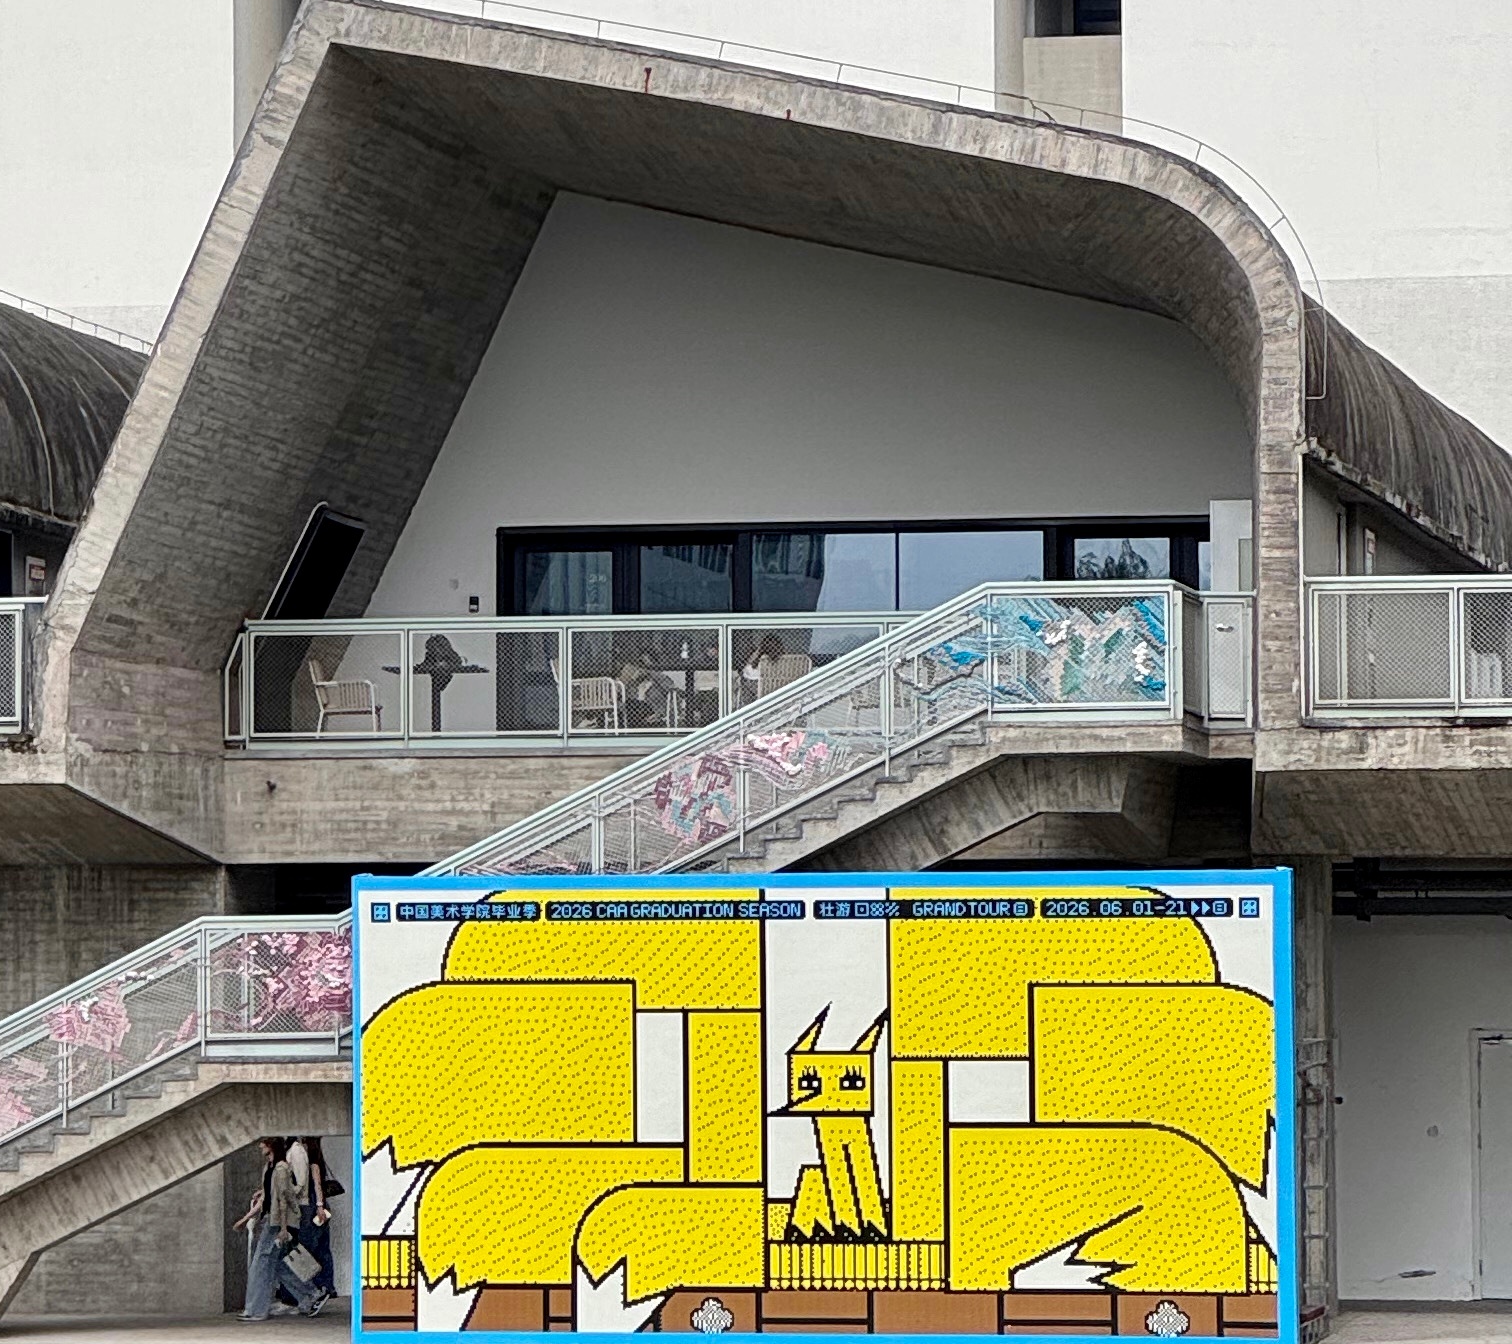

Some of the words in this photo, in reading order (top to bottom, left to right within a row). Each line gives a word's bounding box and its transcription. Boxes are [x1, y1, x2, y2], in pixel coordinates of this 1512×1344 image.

[399, 903, 537, 920] 中国美术学院毕业季
[551, 903, 592, 919] 2026
[596, 903, 628, 918] CAA
[630, 903, 734, 918] GRADUATION
[738, 902, 801, 918] SEASON
[819, 901, 850, 917] 壮游
